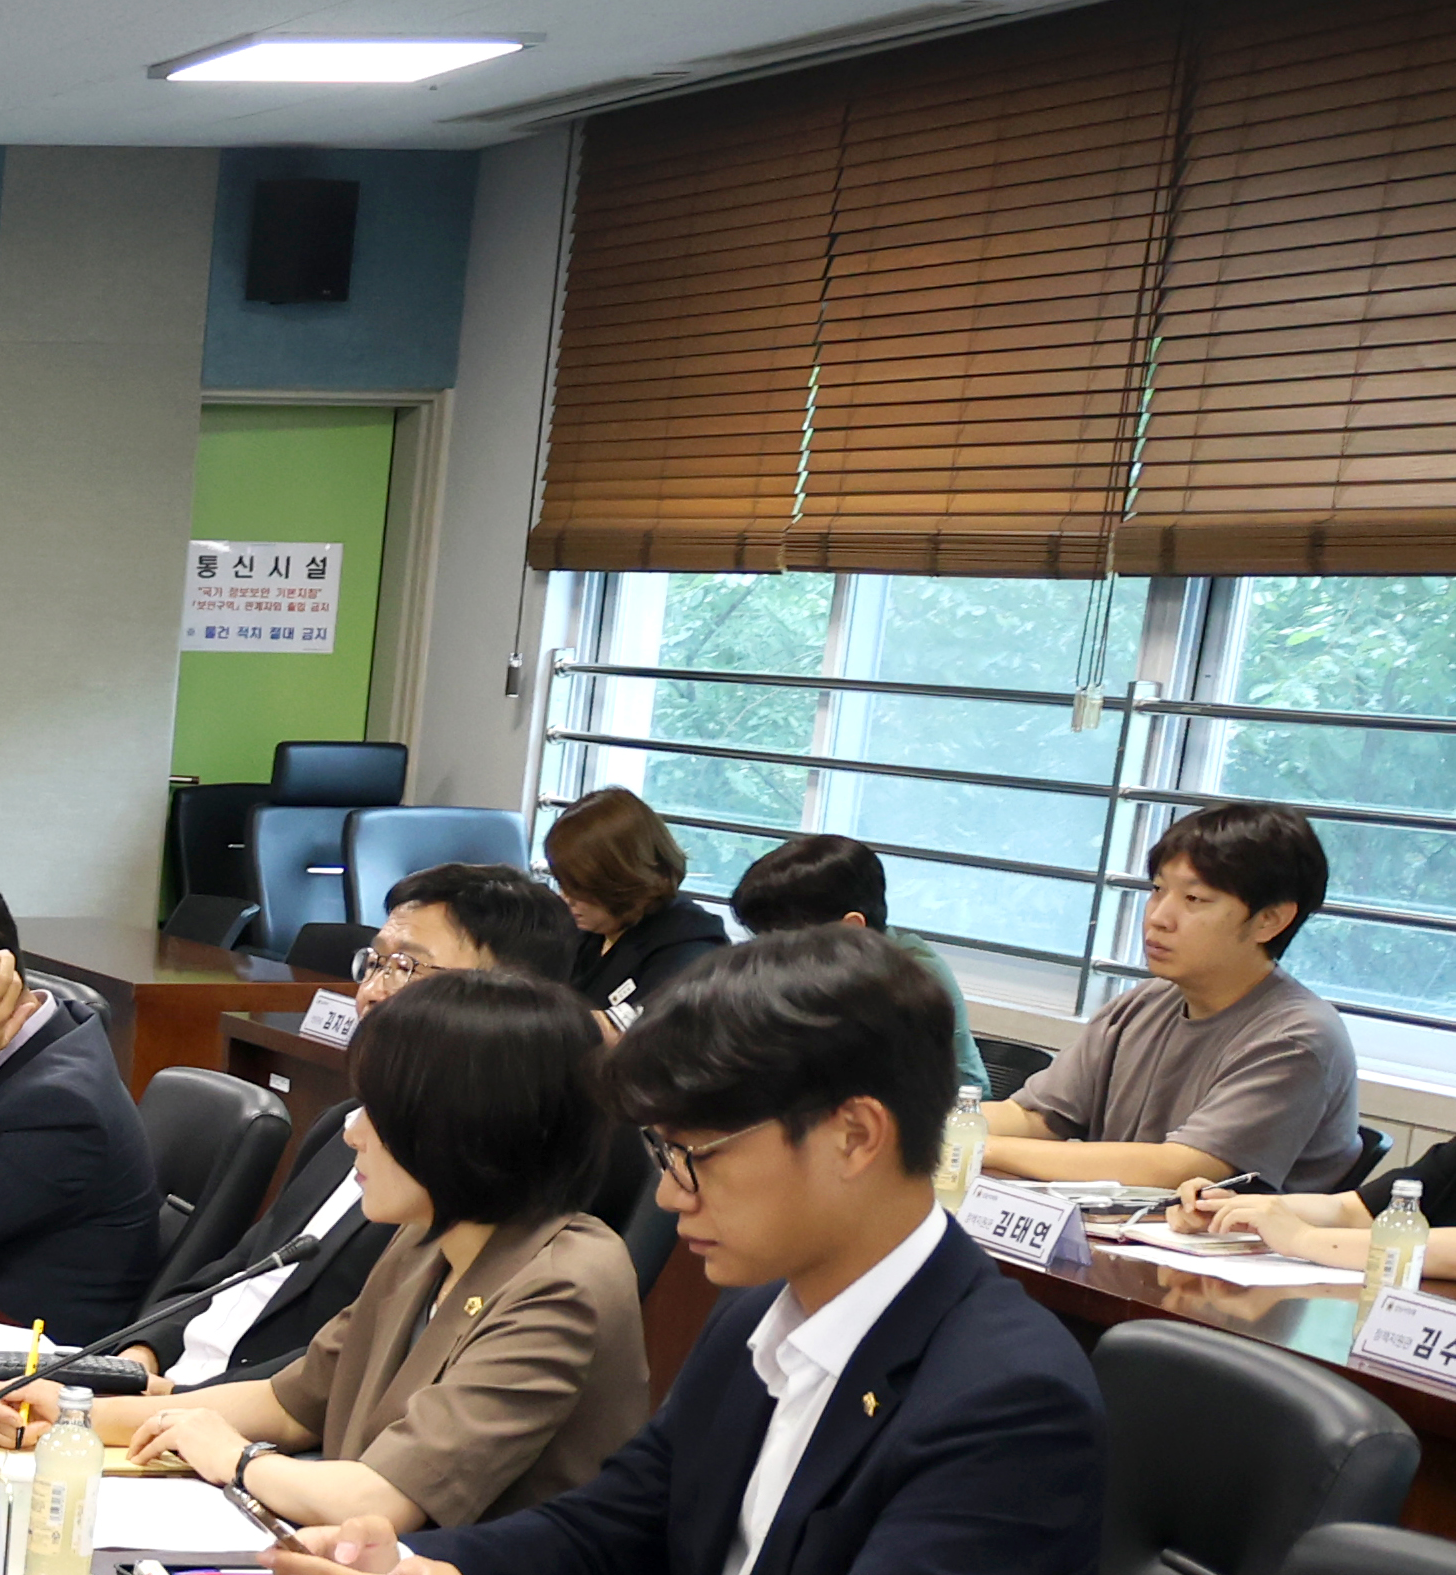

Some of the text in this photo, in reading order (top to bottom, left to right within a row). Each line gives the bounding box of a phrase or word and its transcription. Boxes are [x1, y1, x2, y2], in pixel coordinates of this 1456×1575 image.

[196, 555, 327, 580] 통신시설
[310, 602, 330, 612] 금지
[205, 625, 230, 640] 물건
[270, 626, 295, 641] 절대
[302, 627, 328, 641] 금지
[992, 1210, 1052, 1249] 김태연
